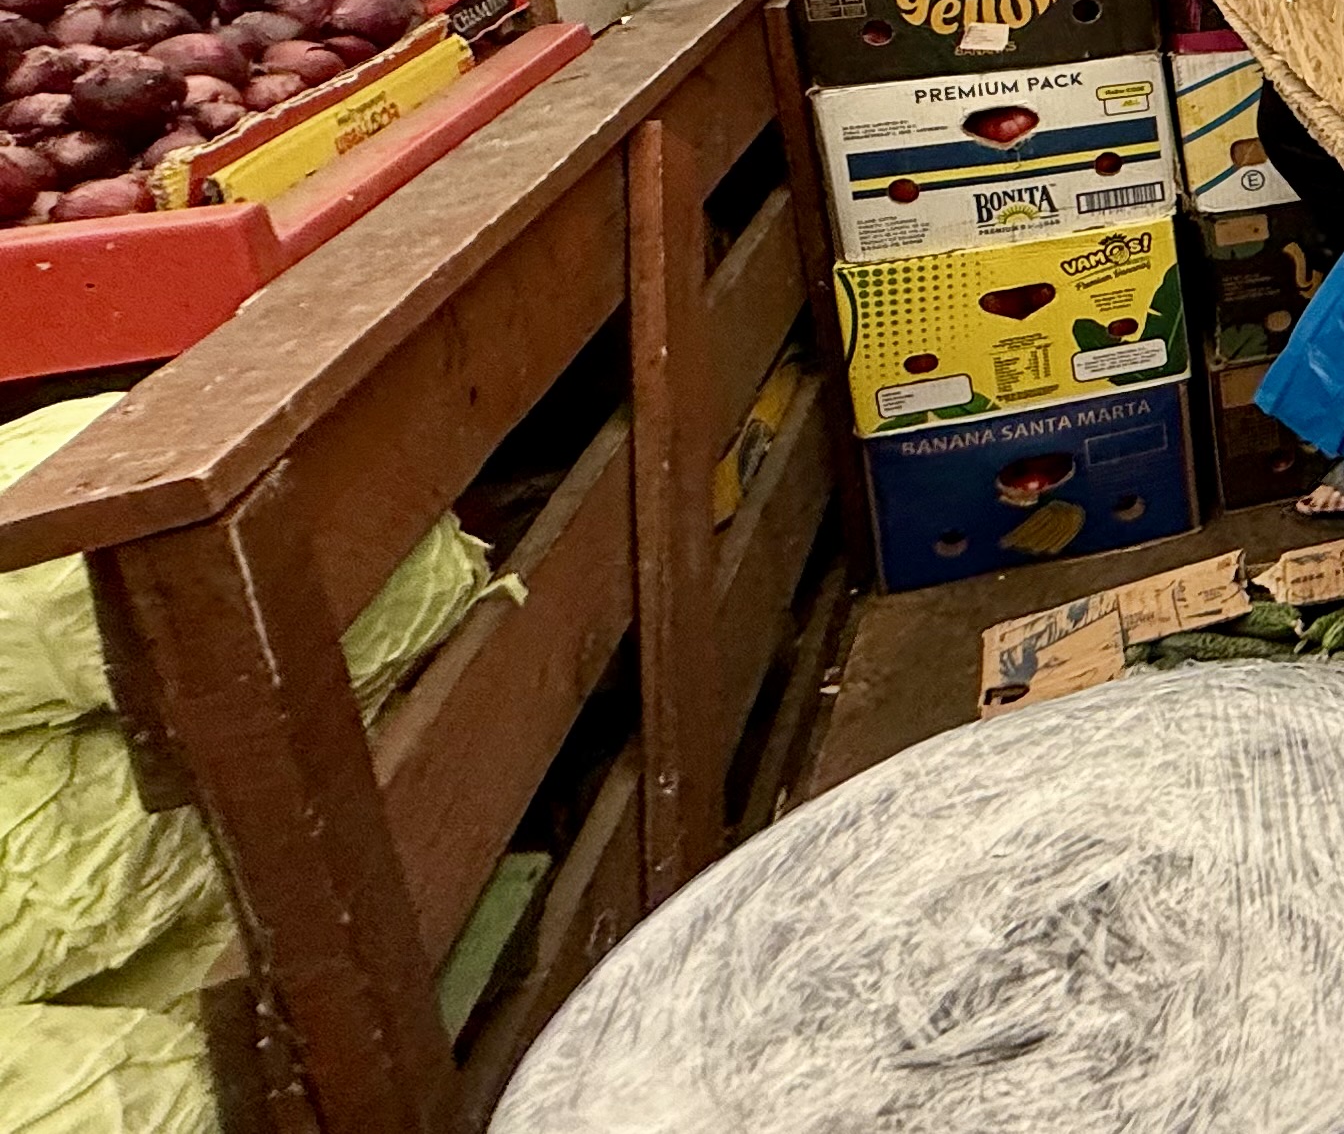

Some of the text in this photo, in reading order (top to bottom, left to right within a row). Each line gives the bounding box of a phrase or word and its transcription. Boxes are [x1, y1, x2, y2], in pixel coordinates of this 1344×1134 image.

[914, 72, 1083, 104] PREMIUM PACK
[973, 184, 1059, 224] BONITA
[901, 399, 1151, 456] BANANA SANTA MARTA
